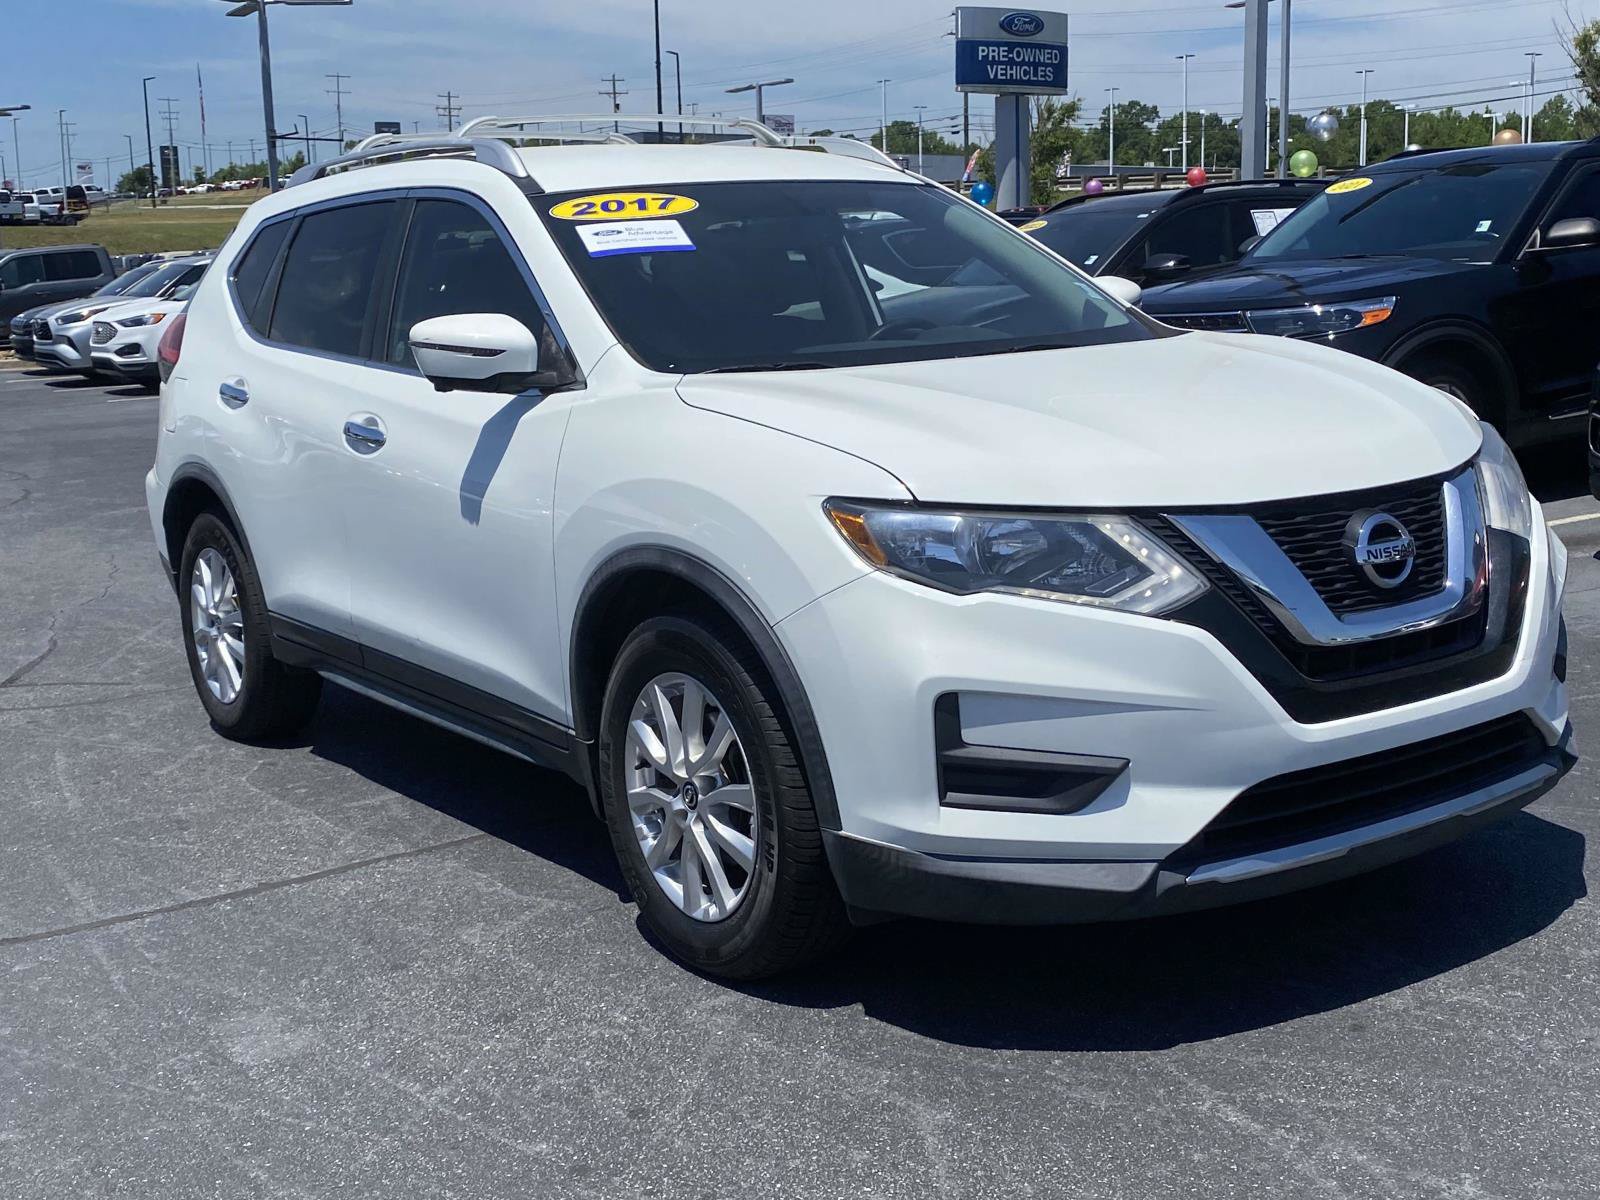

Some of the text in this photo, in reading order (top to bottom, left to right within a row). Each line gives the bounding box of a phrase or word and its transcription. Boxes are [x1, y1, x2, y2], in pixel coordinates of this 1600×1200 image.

[1011, 17, 1037, 32] Ford
[978, 46, 1060, 64] PRE-OWNED
[987, 65, 1054, 82] VEHICLES
[571, 197, 677, 217] 2017
[1366, 543, 1414, 560] NISSAN
